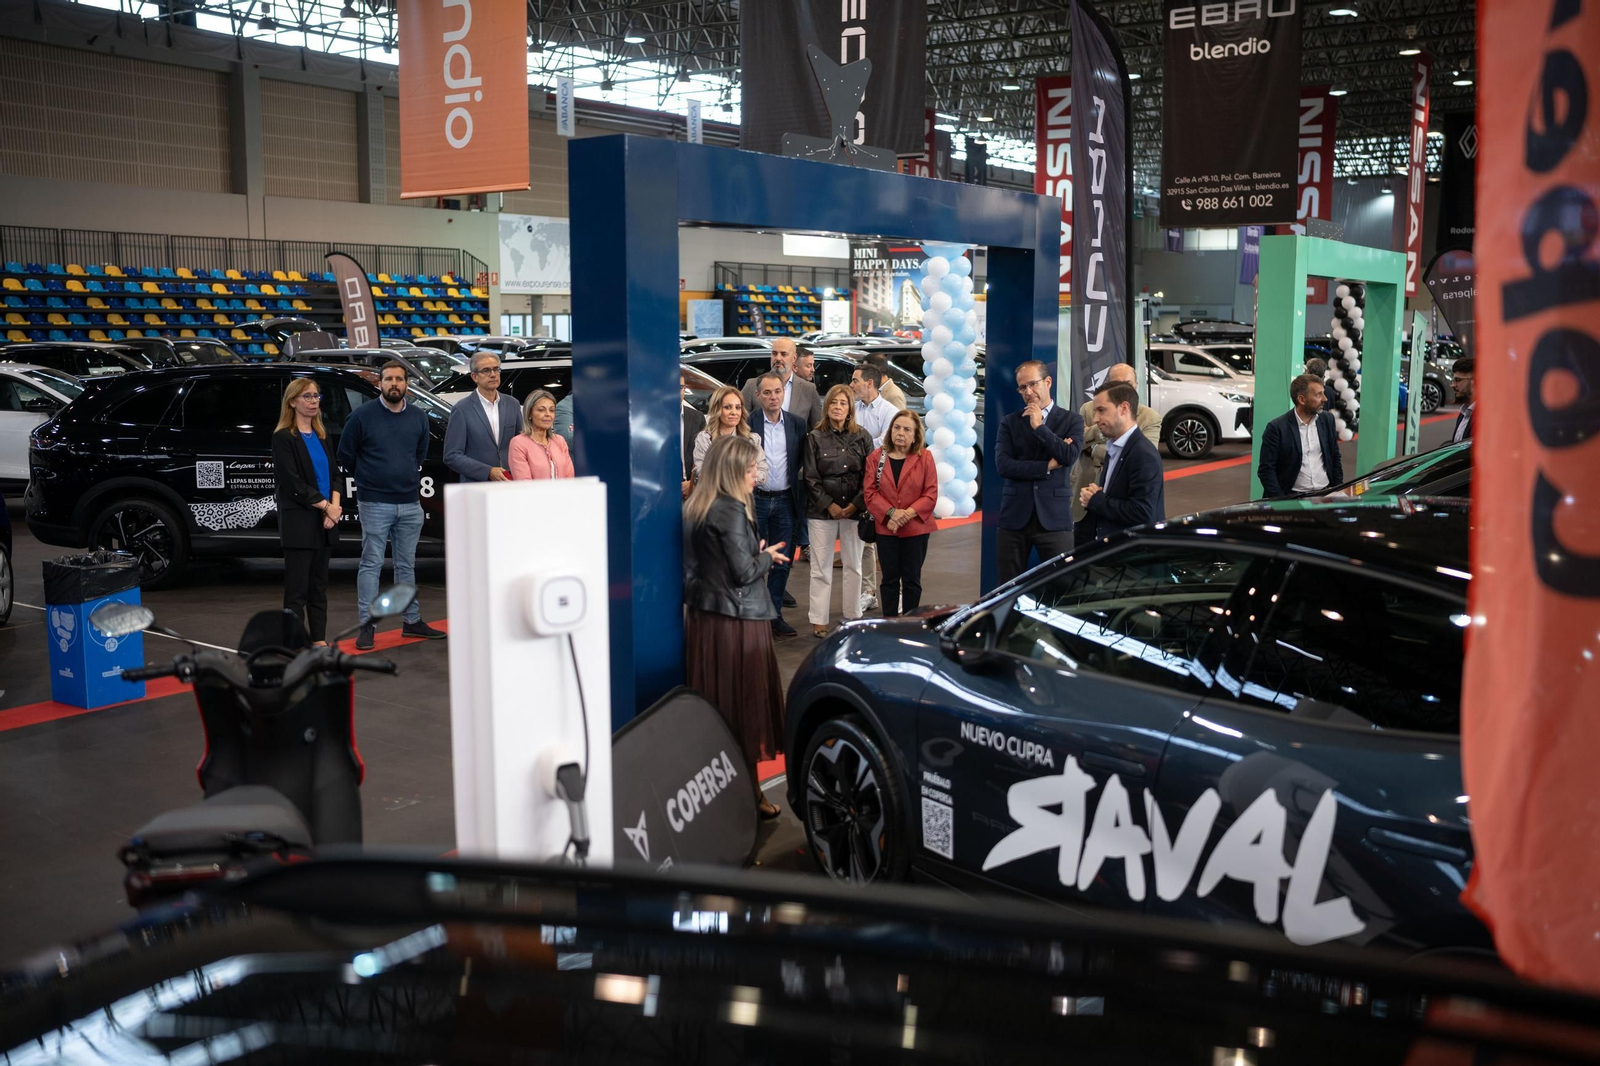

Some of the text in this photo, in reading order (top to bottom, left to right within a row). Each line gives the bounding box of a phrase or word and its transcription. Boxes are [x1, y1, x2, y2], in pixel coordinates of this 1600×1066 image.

[1190, 37, 1271, 61] blendio
[1174, 176, 1190, 185] Calle
[1221, 173, 1233, 181] Pol.
[1233, 173, 1251, 181] Com.
[1252, 171, 1281, 179] Barreiros
[1406, 63, 1427, 292] NISSAN
[1166, 182, 1290, 196] 32915 San Cibrao Das Viñas blendio.es
[1196, 194, 1273, 210] 988 661 002
[853, 247, 878, 259] MINI
[853, 258, 921, 270] HAPPY DAYS.
[960, 721, 1055, 769] NUEVO CUPRA
[666, 750, 737, 833] COPERSA
